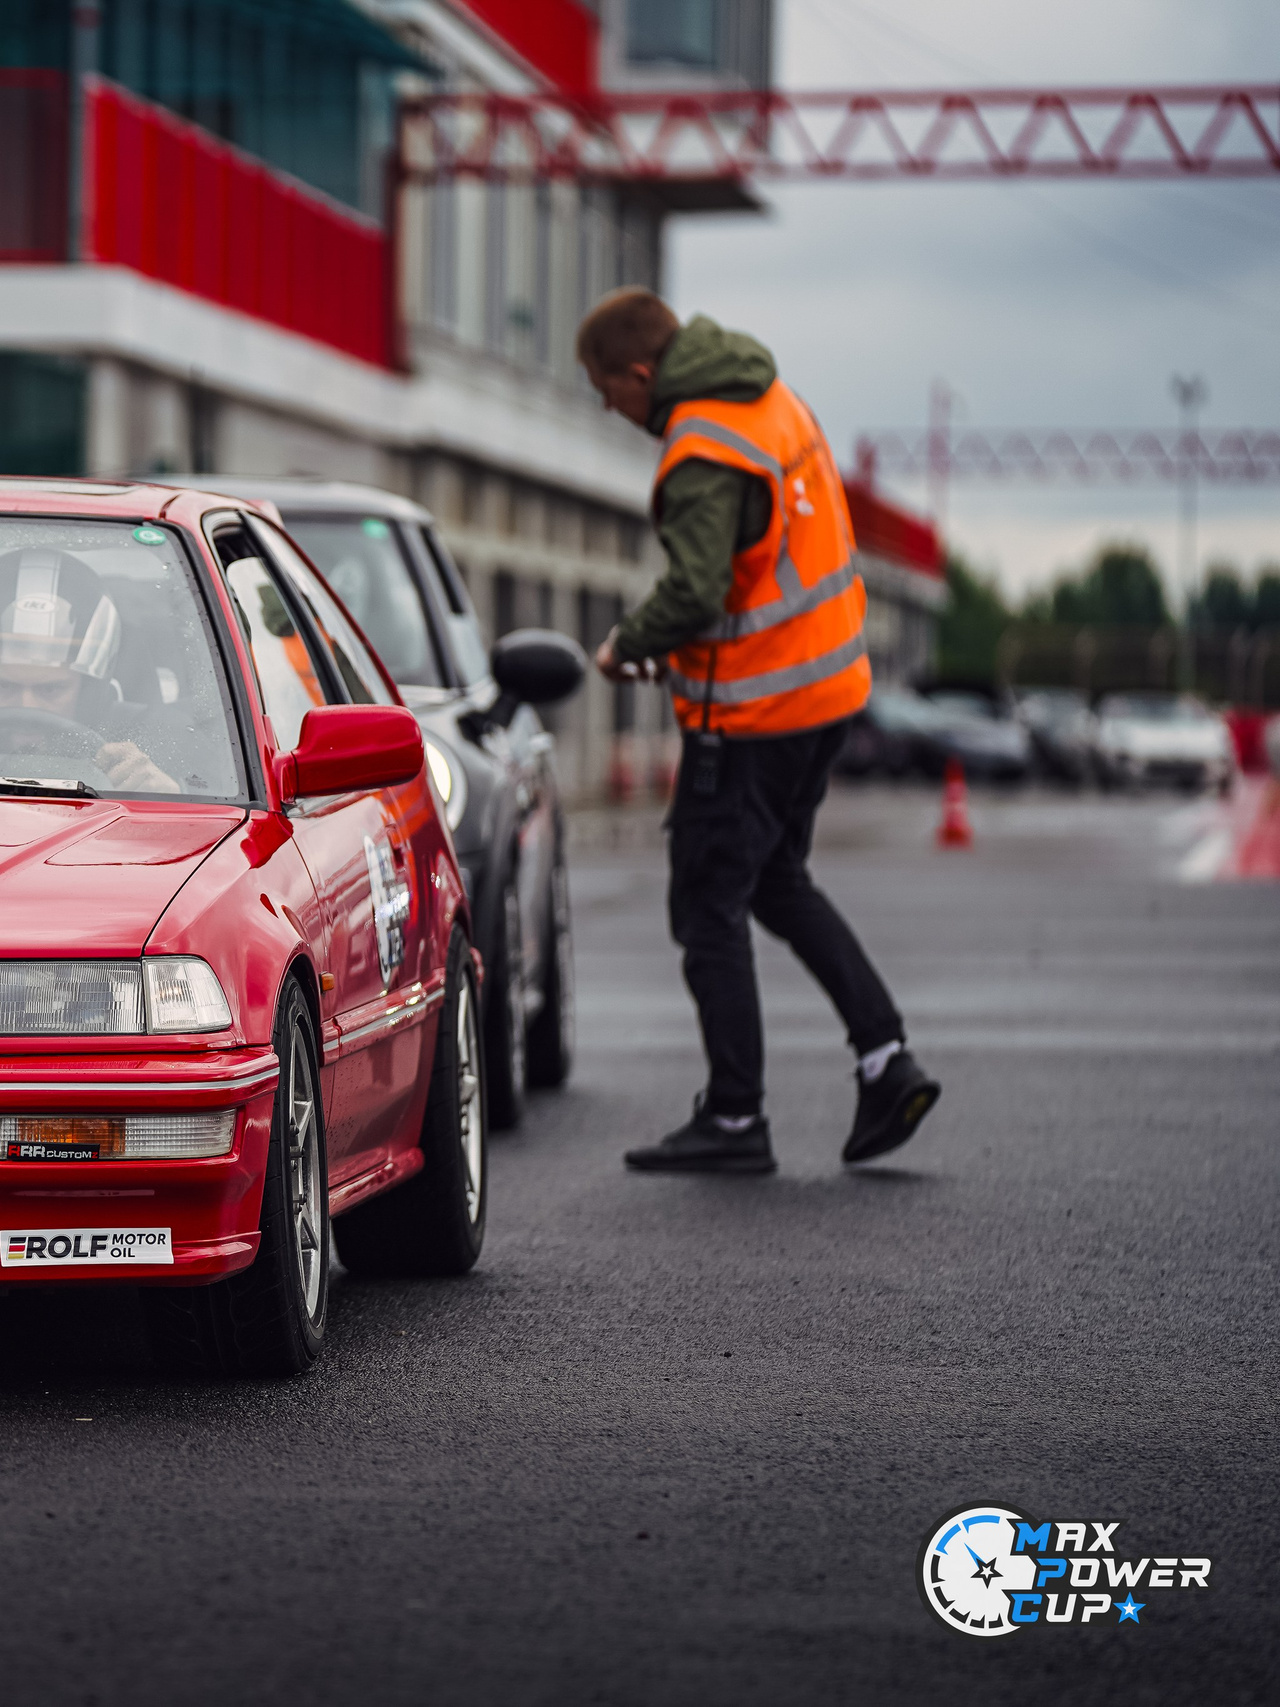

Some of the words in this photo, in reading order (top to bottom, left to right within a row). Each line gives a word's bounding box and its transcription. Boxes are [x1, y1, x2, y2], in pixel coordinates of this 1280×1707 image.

[112, 1233, 166, 1245] MOTOR
[25, 1235, 109, 1259] ROLF
[110, 1247, 136, 1258] OIL
